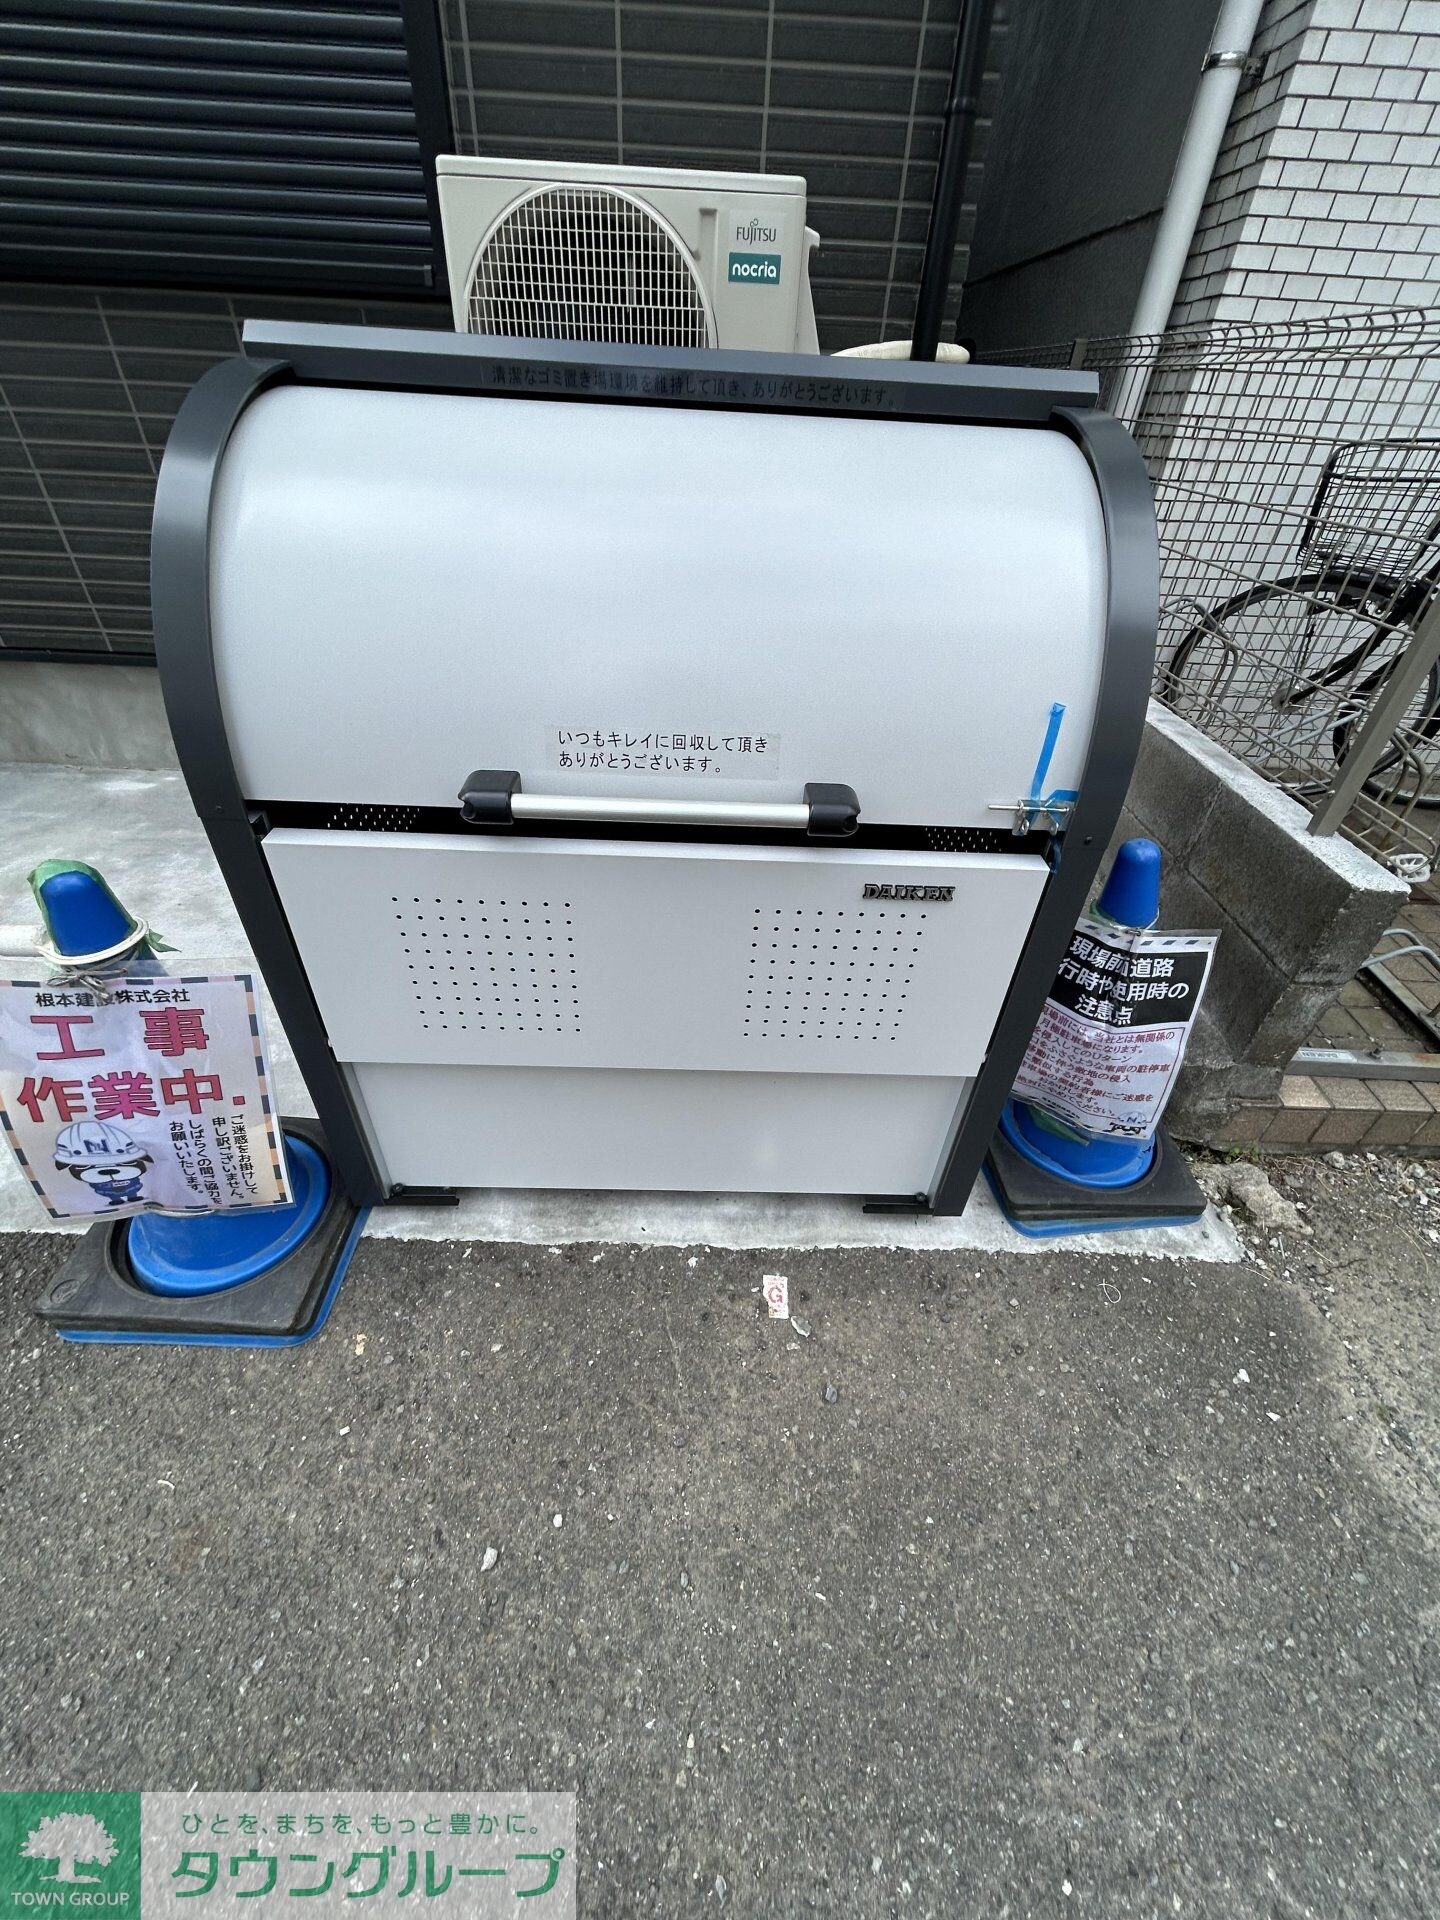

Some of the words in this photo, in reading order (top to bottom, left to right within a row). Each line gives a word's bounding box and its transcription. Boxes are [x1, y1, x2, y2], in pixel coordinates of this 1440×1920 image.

[736, 218, 777, 245] FUJITSU
[732, 261, 777, 278] nocria
[558, 730, 768, 753] いつもキレイに回収して頂き
[558, 750, 721, 773] ありがとうございます。
[862, 883, 956, 901] DAIKEN
[1075, 994, 1133, 1025] 注意点
[169, 1121, 203, 1194] お願いいたします。
[189, 1119, 222, 1205] しばらくの間ご協力を
[212, 1117, 244, 1199] 申し訳ございません。
[231, 1114, 258, 1194] ご迷惑をお掛けして
